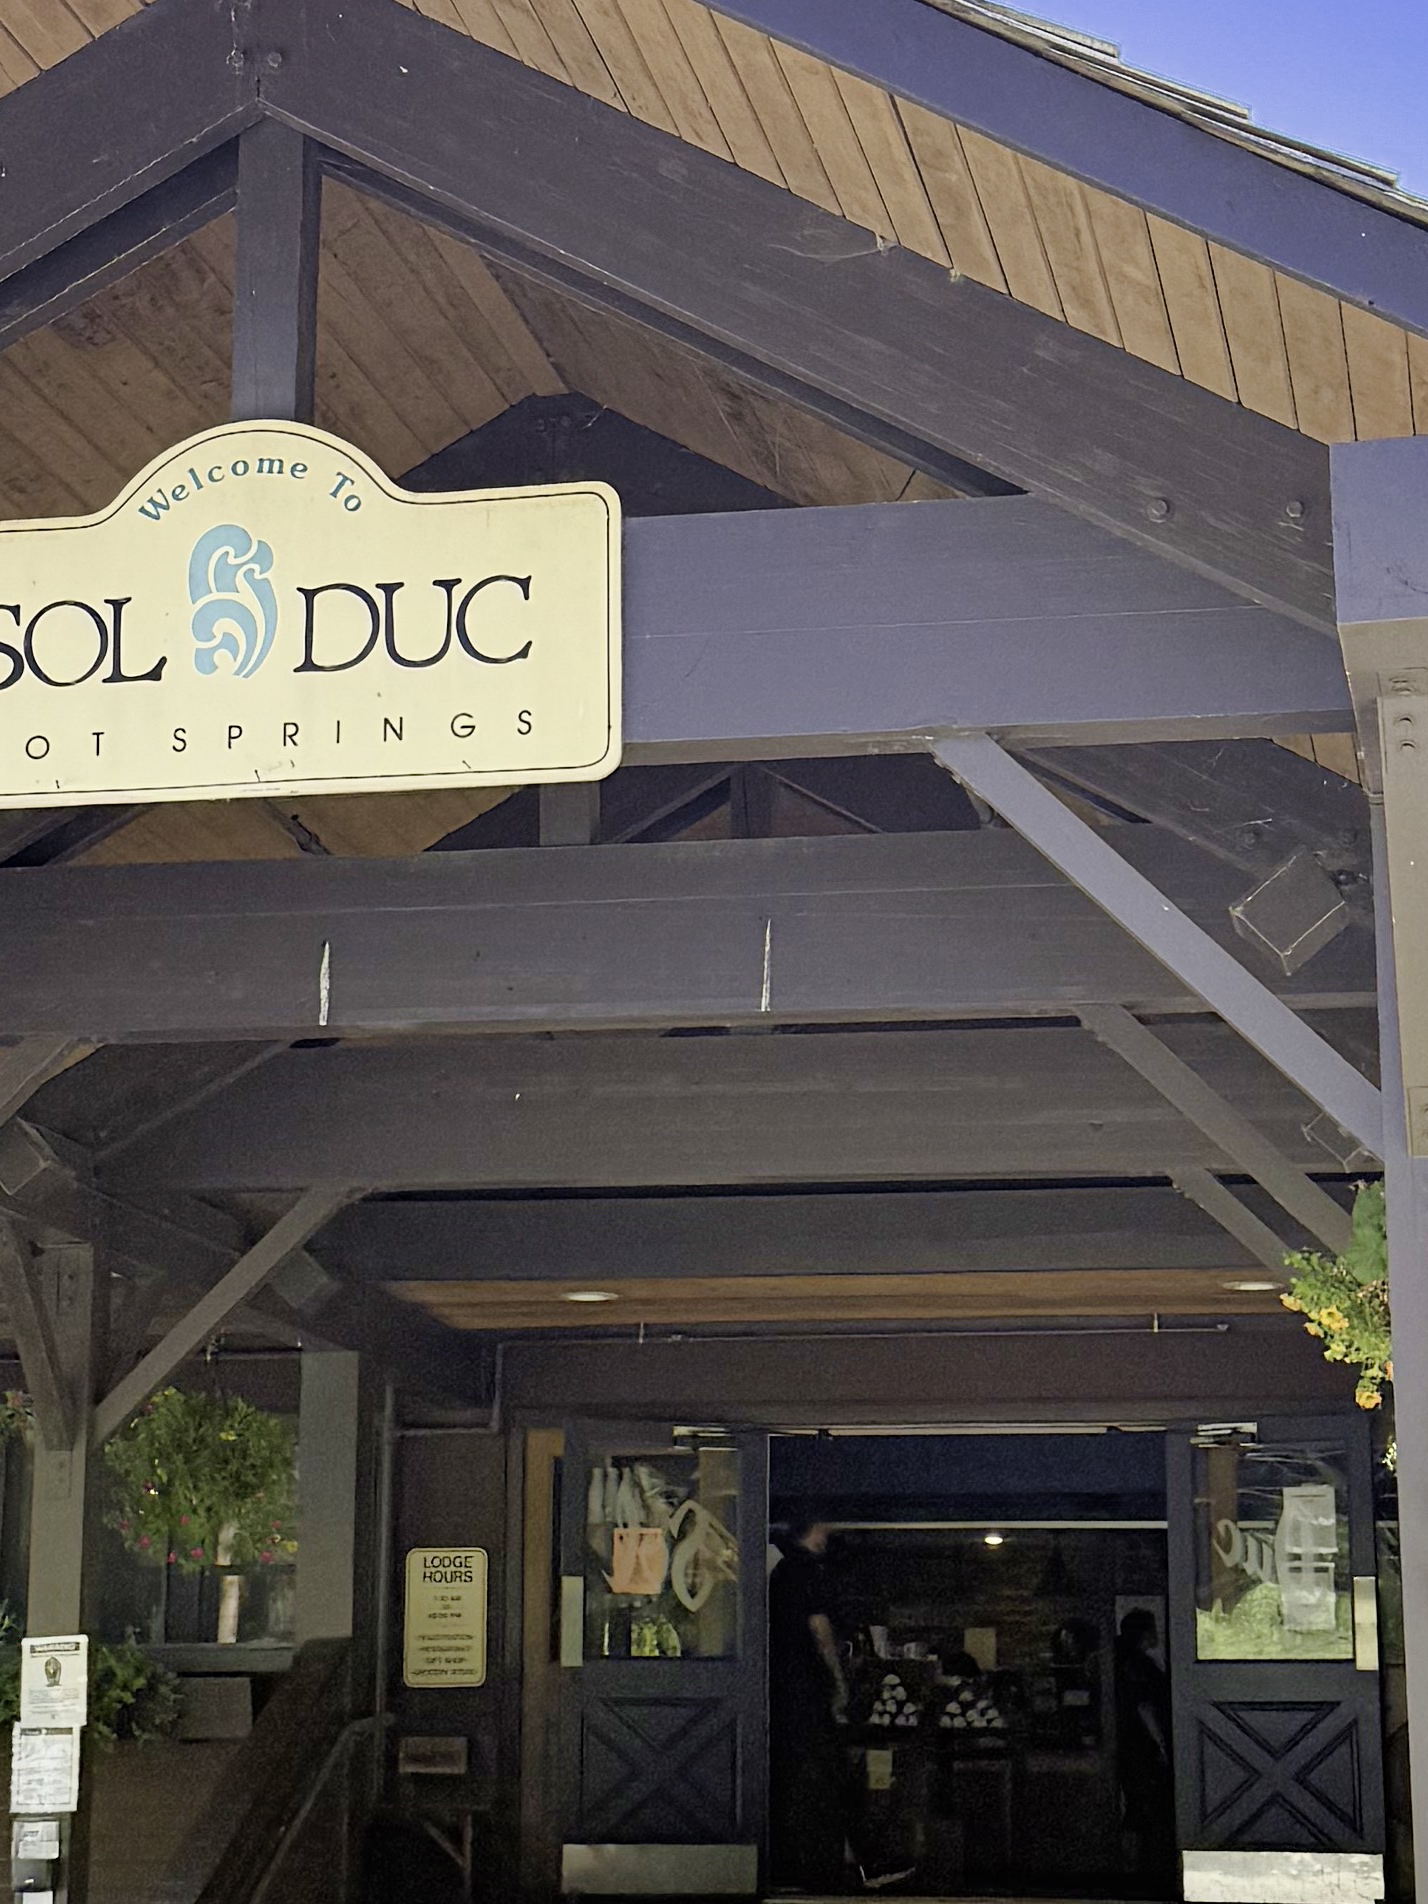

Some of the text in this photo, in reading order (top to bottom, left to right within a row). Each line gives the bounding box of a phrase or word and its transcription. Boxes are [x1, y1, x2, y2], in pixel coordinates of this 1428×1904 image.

[137, 453, 364, 524] Welcome To
[292, 574, 533, 674] DUC
[171, 708, 534, 755] SPRINGS
[421, 1570, 474, 1584] HOURS
[422, 1555, 475, 1569] LODGE
